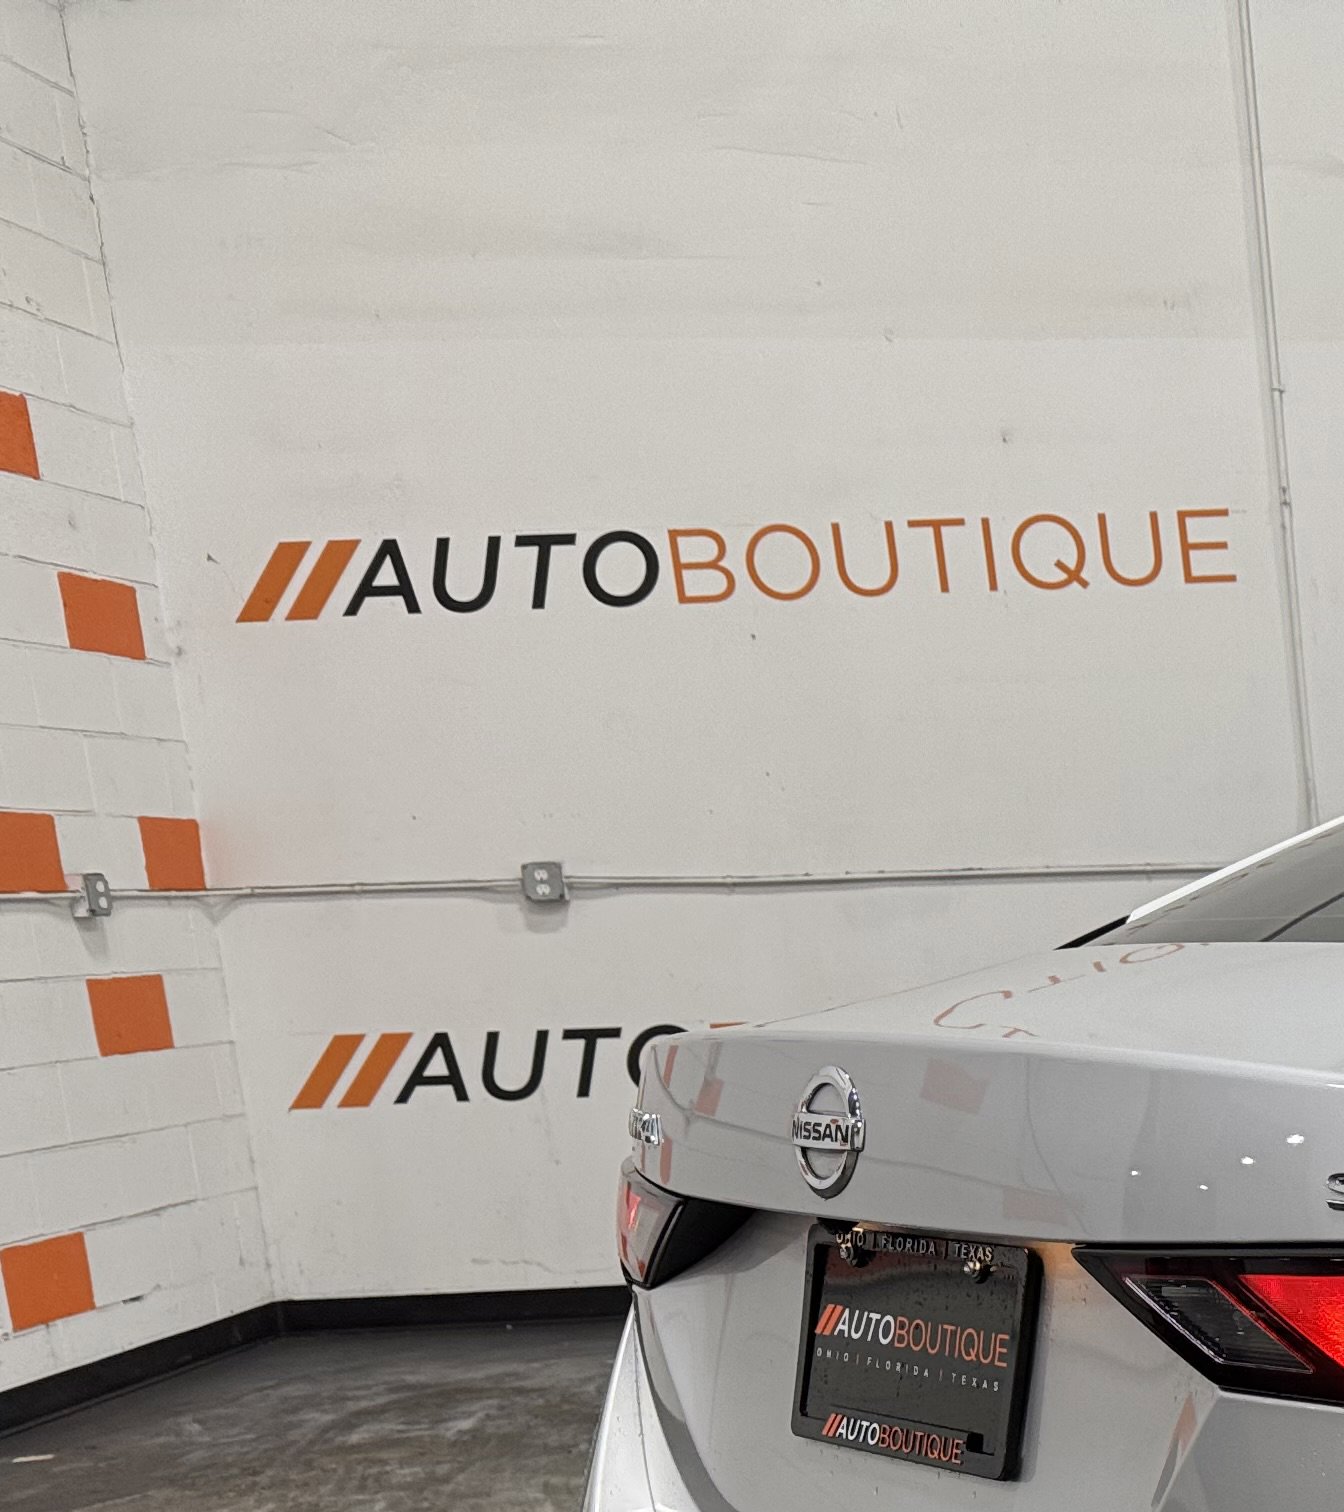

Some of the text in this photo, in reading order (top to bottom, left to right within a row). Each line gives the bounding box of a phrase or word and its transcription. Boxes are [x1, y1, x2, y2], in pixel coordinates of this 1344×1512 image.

[792, 1118, 849, 1144] NISSAN
[881, 1234, 936, 1257] FLORIDA
[954, 1242, 993, 1261] TEXAS
[866, 1356, 929, 1378] FLORIDA
[951, 1372, 999, 1392] TEXAS
